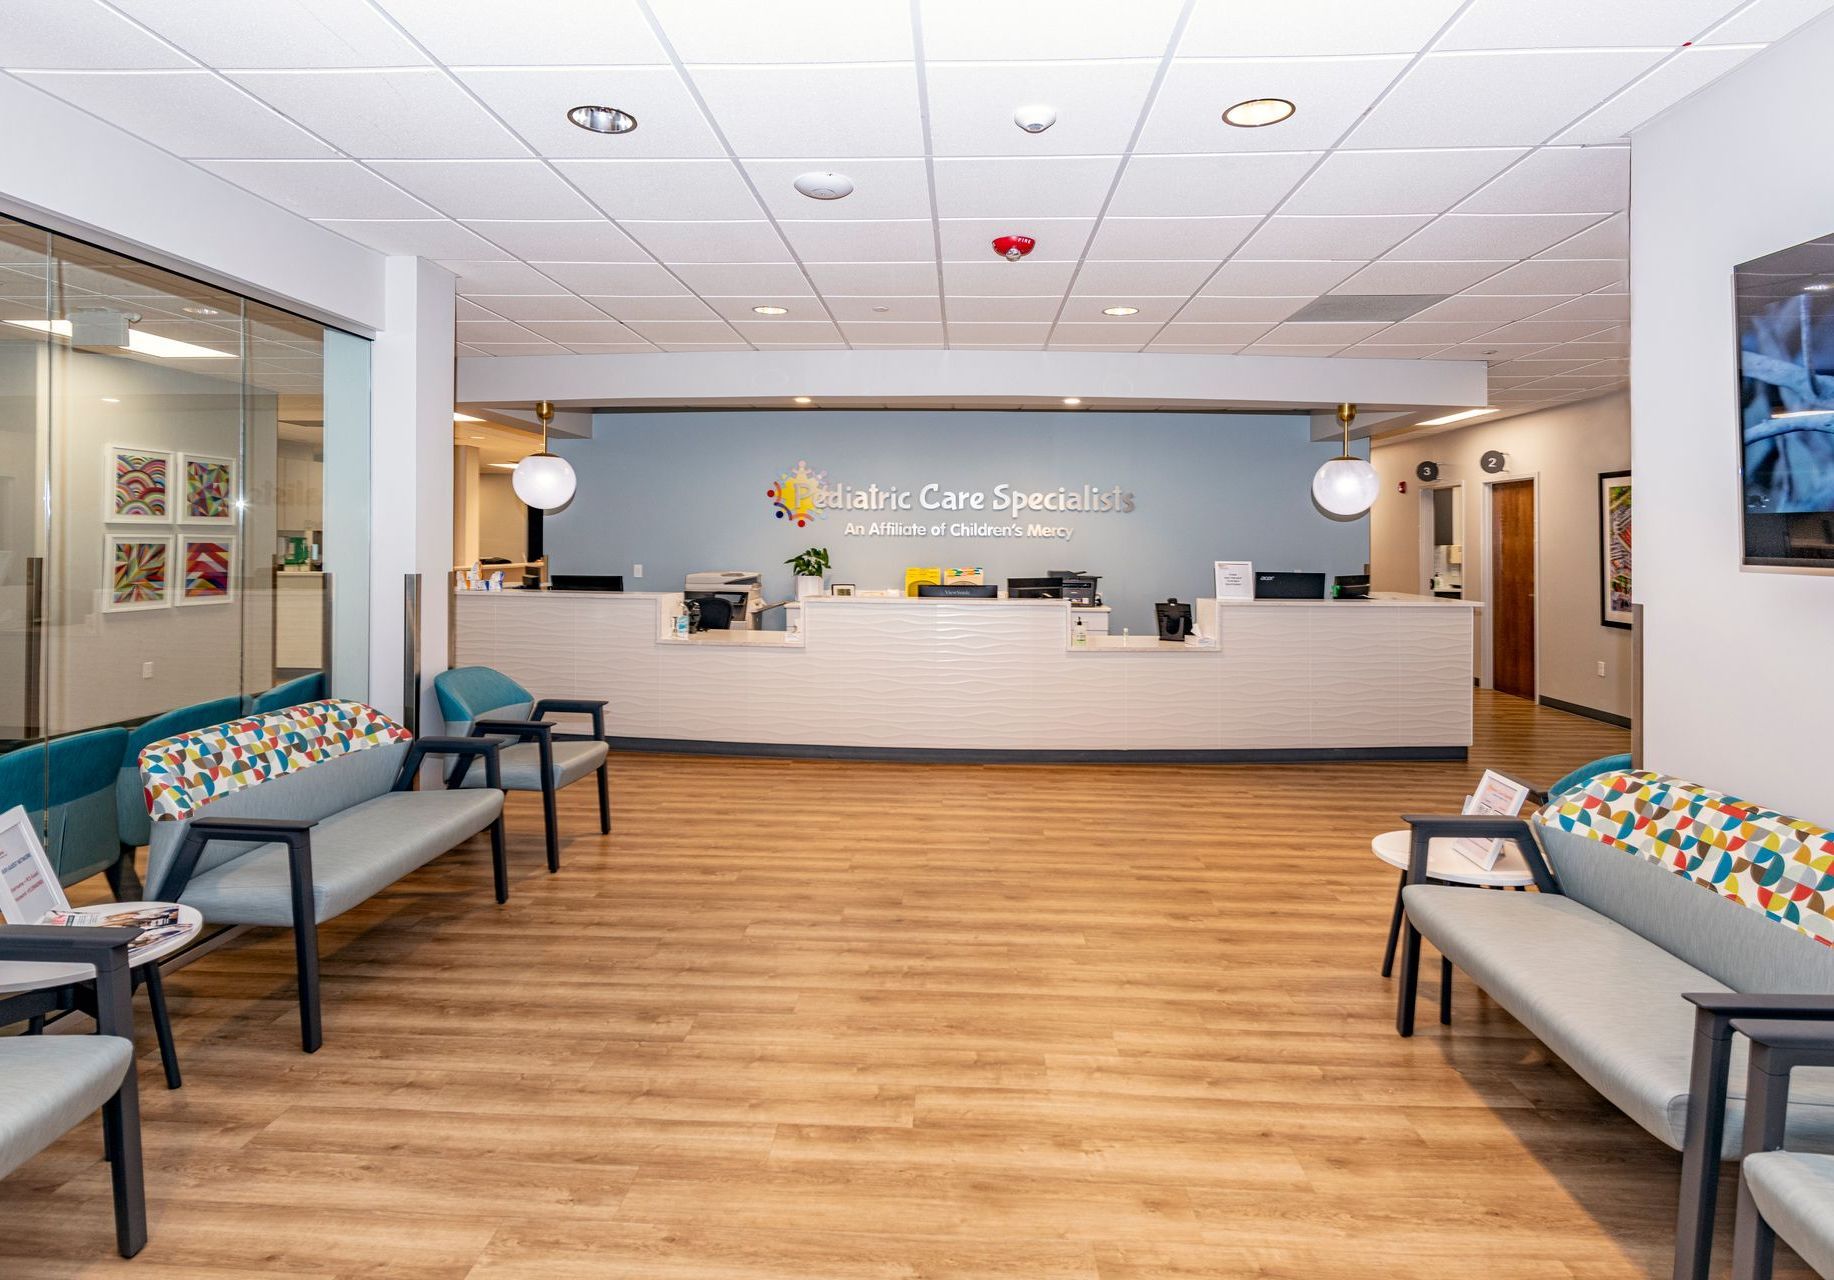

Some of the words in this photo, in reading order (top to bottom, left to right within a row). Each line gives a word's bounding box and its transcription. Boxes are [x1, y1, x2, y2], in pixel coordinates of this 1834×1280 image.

[1488, 457, 1497, 467] 2
[1423, 467, 1431, 475] 3
[794, 482, 912, 511] Pediatric
[919, 483, 985, 511] Care
[992, 483, 1136, 519] Specialists
[844, 522, 865, 537] An
[868, 522, 927, 537] Affiliate
[930, 522, 947, 537] of
[949, 522, 1023, 538] Children's
[1026, 523, 1074, 541] Mercy
